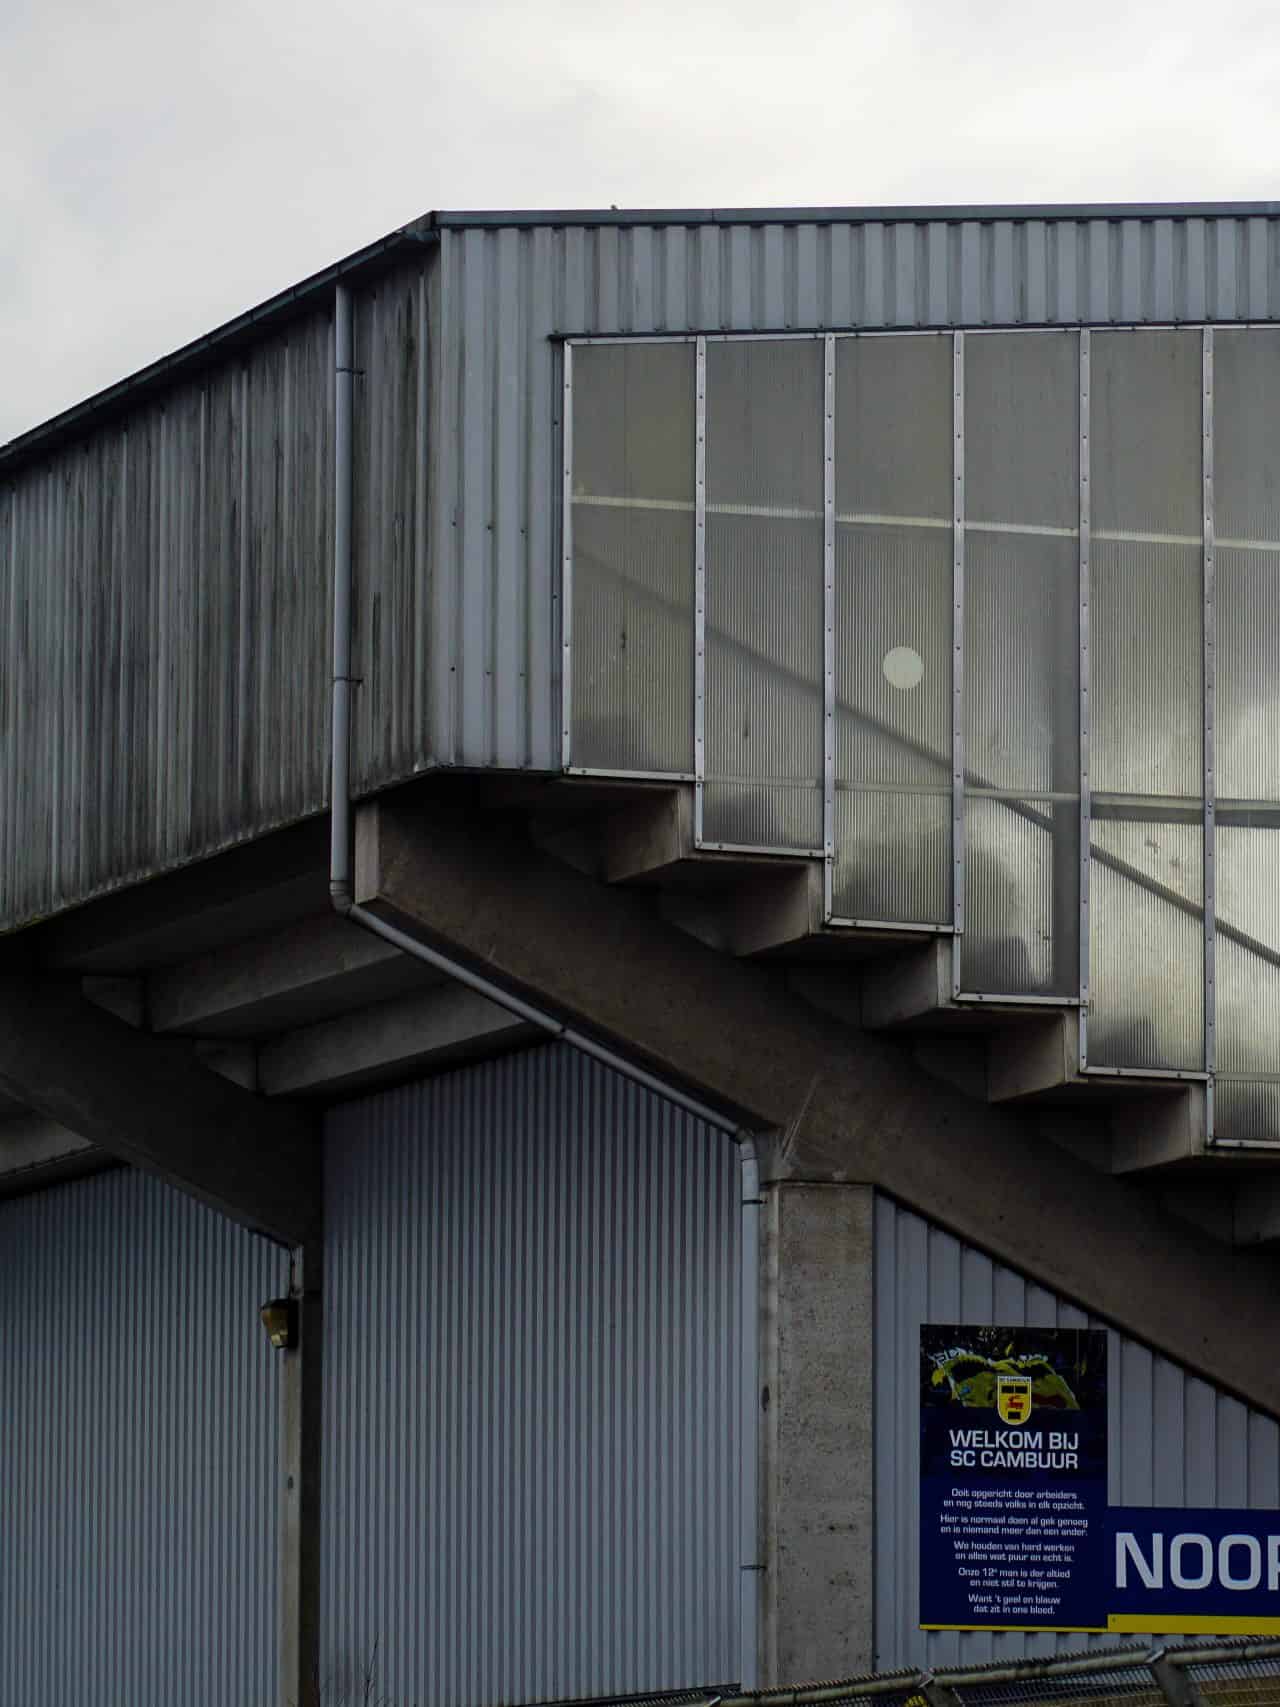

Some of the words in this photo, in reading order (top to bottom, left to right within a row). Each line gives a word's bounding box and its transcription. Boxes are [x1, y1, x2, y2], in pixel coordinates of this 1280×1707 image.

[949, 1430, 1042, 1449] WELKOM
[1049, 1432, 1078, 1450] BIJ
[950, 1451, 975, 1466] SC
[981, 1451, 1078, 1469] CAMBUUR
[952, 1488, 969, 1497] Ooit
[972, 1488, 1012, 1500] opgericht
[1015, 1489, 1033, 1498] door
[1036, 1490, 1077, 1499] arbeiders
[974, 1500, 1002, 1508] steeds
[1005, 1500, 1026, 1508] volks
[1029, 1500, 1036, 1508] in
[1052, 1501, 1085, 1510] opzicht.
[940, 1514, 959, 1523] Hier
[961, 1515, 968, 1523] is
[971, 1515, 1005, 1524] normaal
[1008, 1516, 1028, 1525] doen
[1031, 1516, 1038, 1525] al
[1040, 1517, 1055, 1526] gek
[1057, 1518, 1088, 1527] genoeg
[953, 1525, 961, 1533] is
[963, 1525, 999, 1534] niemand
[954, 1541, 969, 1550] We
[971, 1541, 1003, 1550] houden
[1004, 1543, 1019, 1551] van
[1021, 1542, 1041, 1551] hard
[1043, 1543, 1075, 1552] werken
[968, 1552, 987, 1560] alles
[990, 1553, 1005, 1561] wat
[1008, 1554, 1028, 1562] puur
[1042, 1553, 1062, 1562] echt
[958, 1568, 980, 1576] Onze
[1000, 1569, 1018, 1577] man
[1020, 1568, 1028, 1577] is
[983, 1579, 999, 1587] niet
[1001, 1578, 1014, 1587] stil
[1017, 1579, 1026, 1587] te
[968, 1594, 992, 1603] Want
[1003, 1594, 1021, 1605] geel
[1036, 1595, 1061, 1604] blauw
[973, 1605, 988, 1613] dat
[990, 1604, 1001, 1613] zit
[1003, 1605, 1010, 1613] in
[1012, 1606, 1028, 1614] ons
[1030, 1605, 1055, 1615] bloed.
